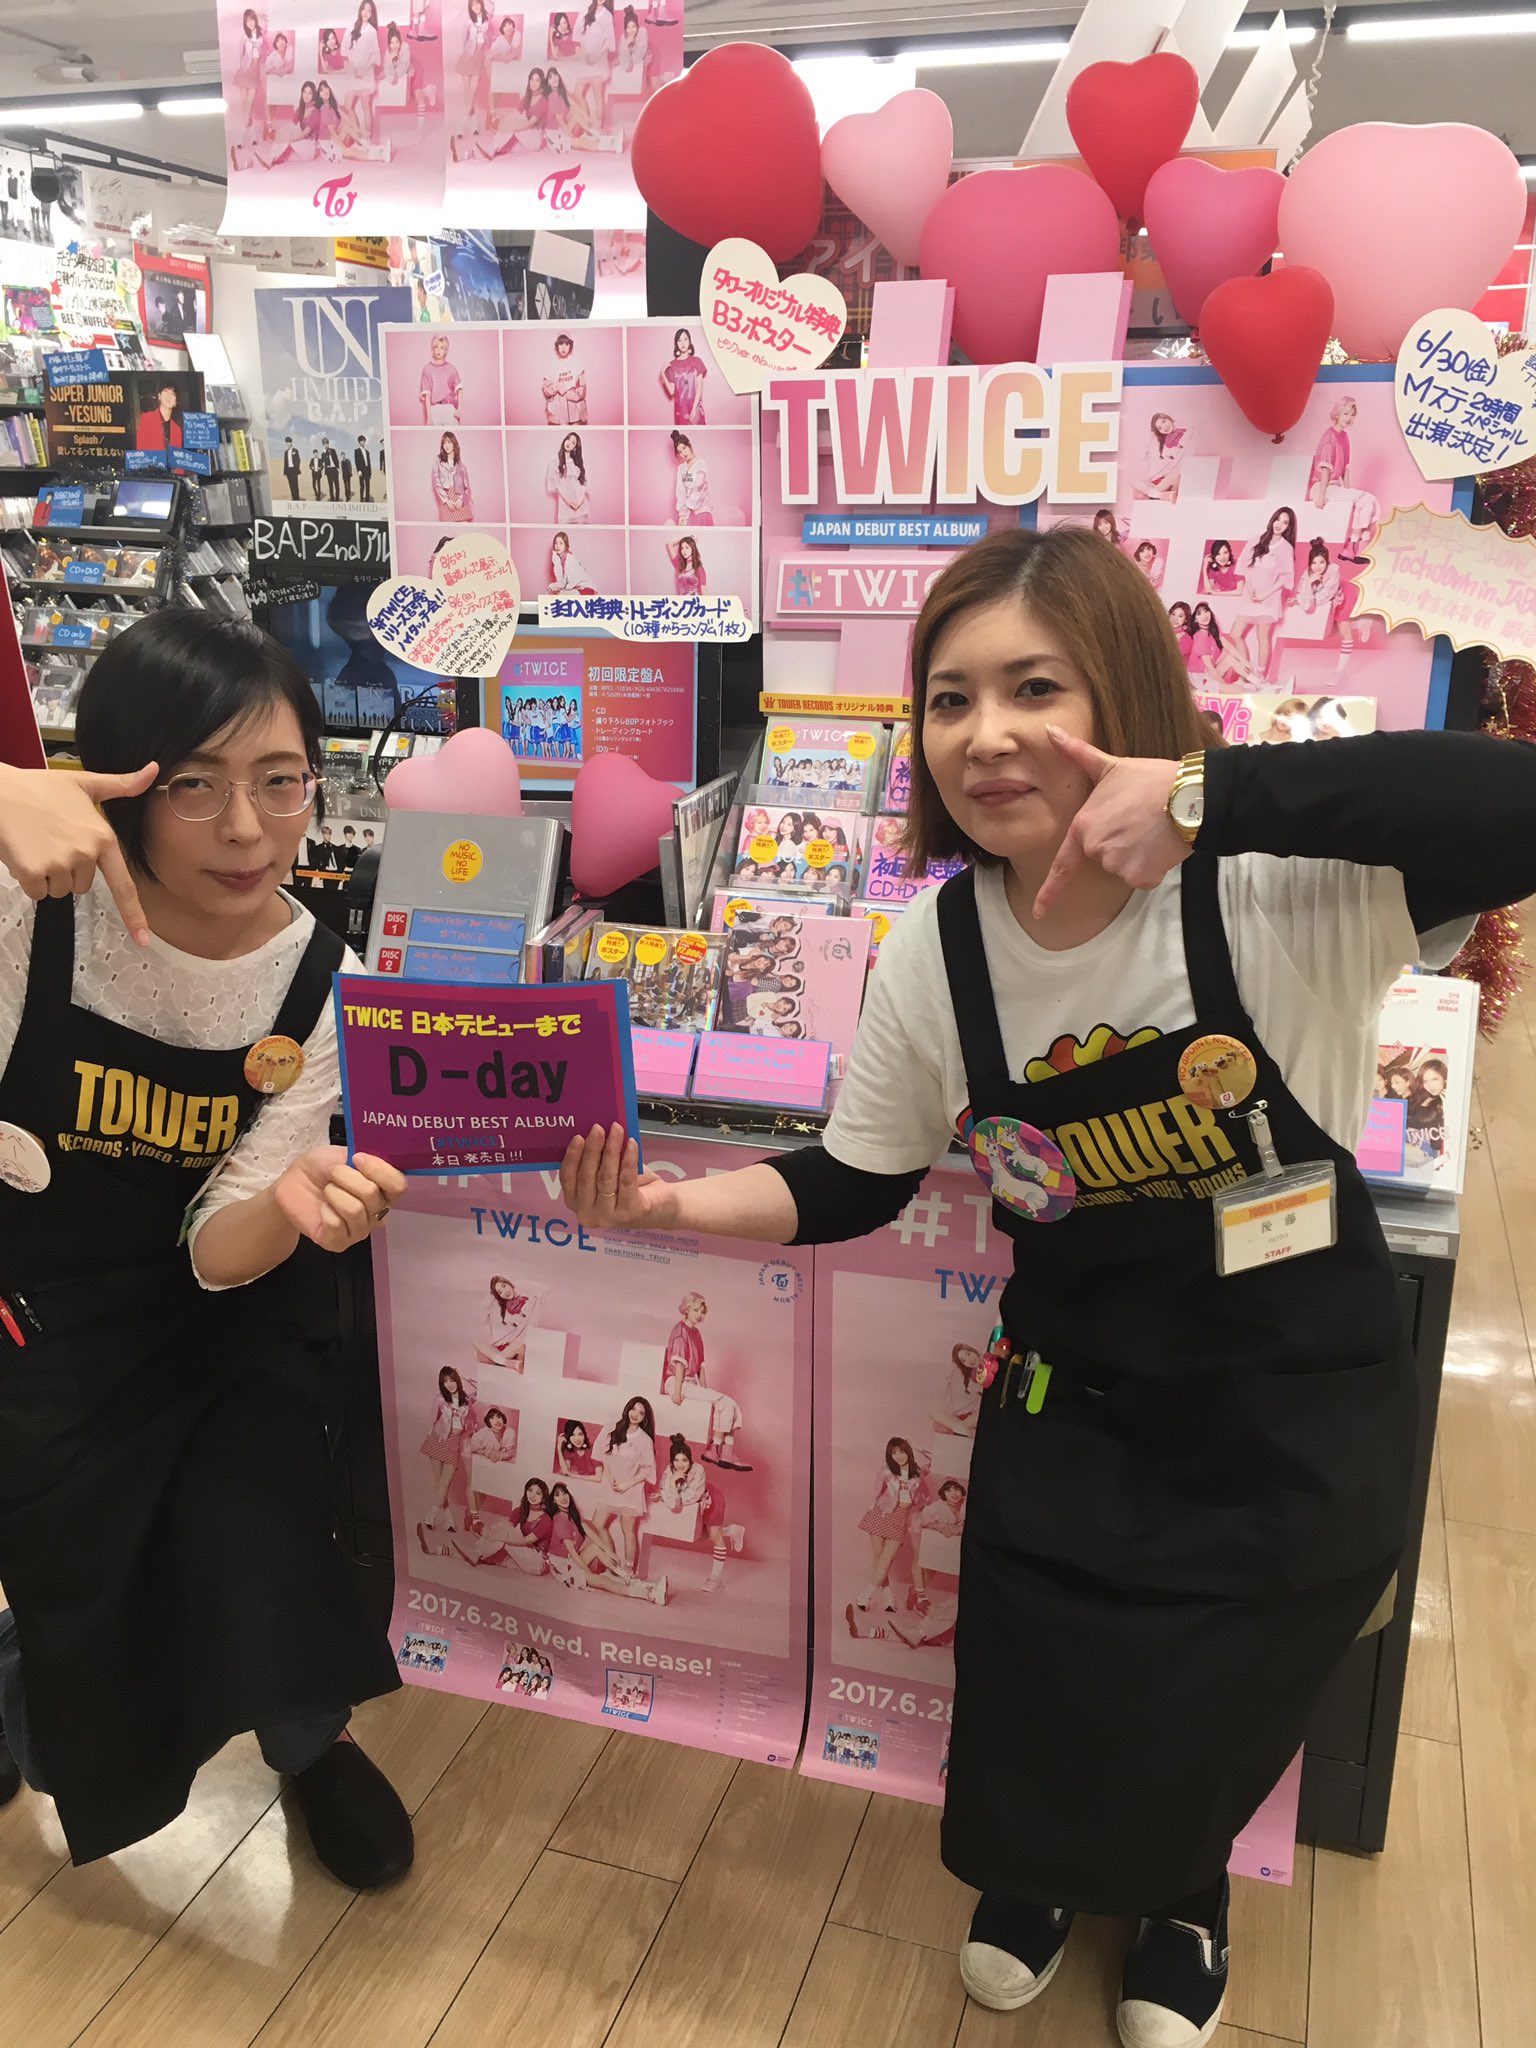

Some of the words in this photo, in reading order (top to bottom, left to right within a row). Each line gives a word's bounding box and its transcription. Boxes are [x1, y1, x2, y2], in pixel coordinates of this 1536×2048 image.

[713, 267, 842, 343] タワーオリジナル特典
[712, 299, 812, 355] B3ポスター
[1416, 329, 1497, 387] 6/30(金)
[50, 384, 84, 403] SUPER
[87, 384, 124, 404] JUNIOR
[1403, 372, 1469, 414] Mステ
[1469, 392, 1523, 425] 2時間
[73, 434, 98, 446] Splash
[766, 368, 1117, 500] TWICE
[1461, 410, 1529, 446] スペシャル
[810, 523, 851, 537] JAPAN
[855, 523, 896, 537] DEBUT
[899, 523, 930, 537] BEST
[933, 523, 981, 538] ALBUM
[58, 629, 70, 638] CD
[71, 629, 86, 639] only
[588, 666, 664, 683] 初回限定盤A
[835, 703, 894, 714] オリジナル特典
[391, 924, 398, 935] 1
[381, 951, 400, 959] DISC
[384, 961, 393, 971] 2
[343, 1005, 404, 1031] TWICE
[412, 1010, 583, 1037] 日本デビューまで
[74, 1059, 240, 1154] TOWER
[362, 1110, 408, 1128] JAPAN
[412, 1115, 466, 1130] DEBUT
[470, 1116, 509, 1130] BEST
[514, 1115, 576, 1129] ALBUM
[57, 1132, 122, 1158] RECORDS
[131, 1141, 172, 1164] VIDEO
[1049, 1093, 1237, 1192] OWER
[1138, 1180, 1184, 1201] VIDEO
[1187, 1162, 1249, 1200] BOOKS
[470, 1207, 597, 1252] TWICE
[1264, 1245, 1292, 1259] STAFF
[407, 1589, 519, 1636] 2017.6.28
[528, 1621, 590, 1658] Wed.
[600, 1640, 713, 1677] Release!
